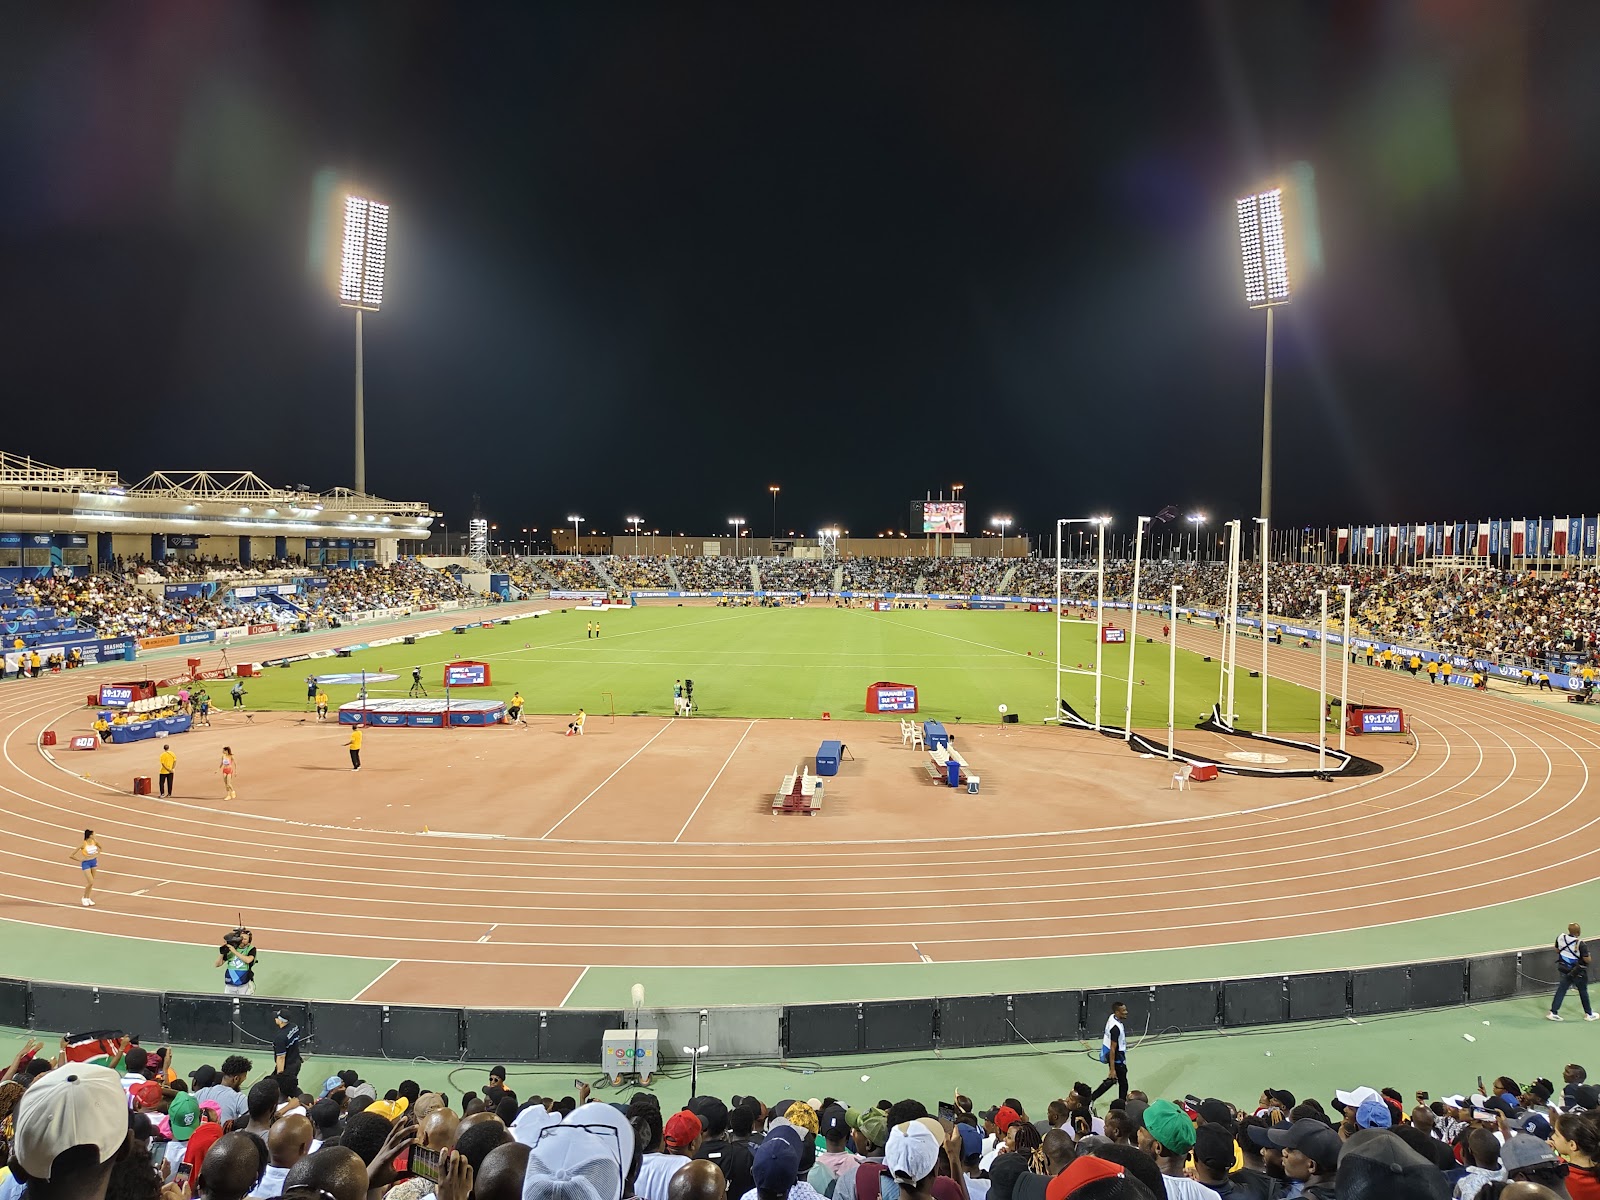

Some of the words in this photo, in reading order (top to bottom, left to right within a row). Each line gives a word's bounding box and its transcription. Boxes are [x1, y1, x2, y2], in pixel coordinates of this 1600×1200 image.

[258, 625, 273, 633] OMEGA
[102, 689, 131, 698] 19:17:07
[1364, 714, 1399, 723] 19:17:07
